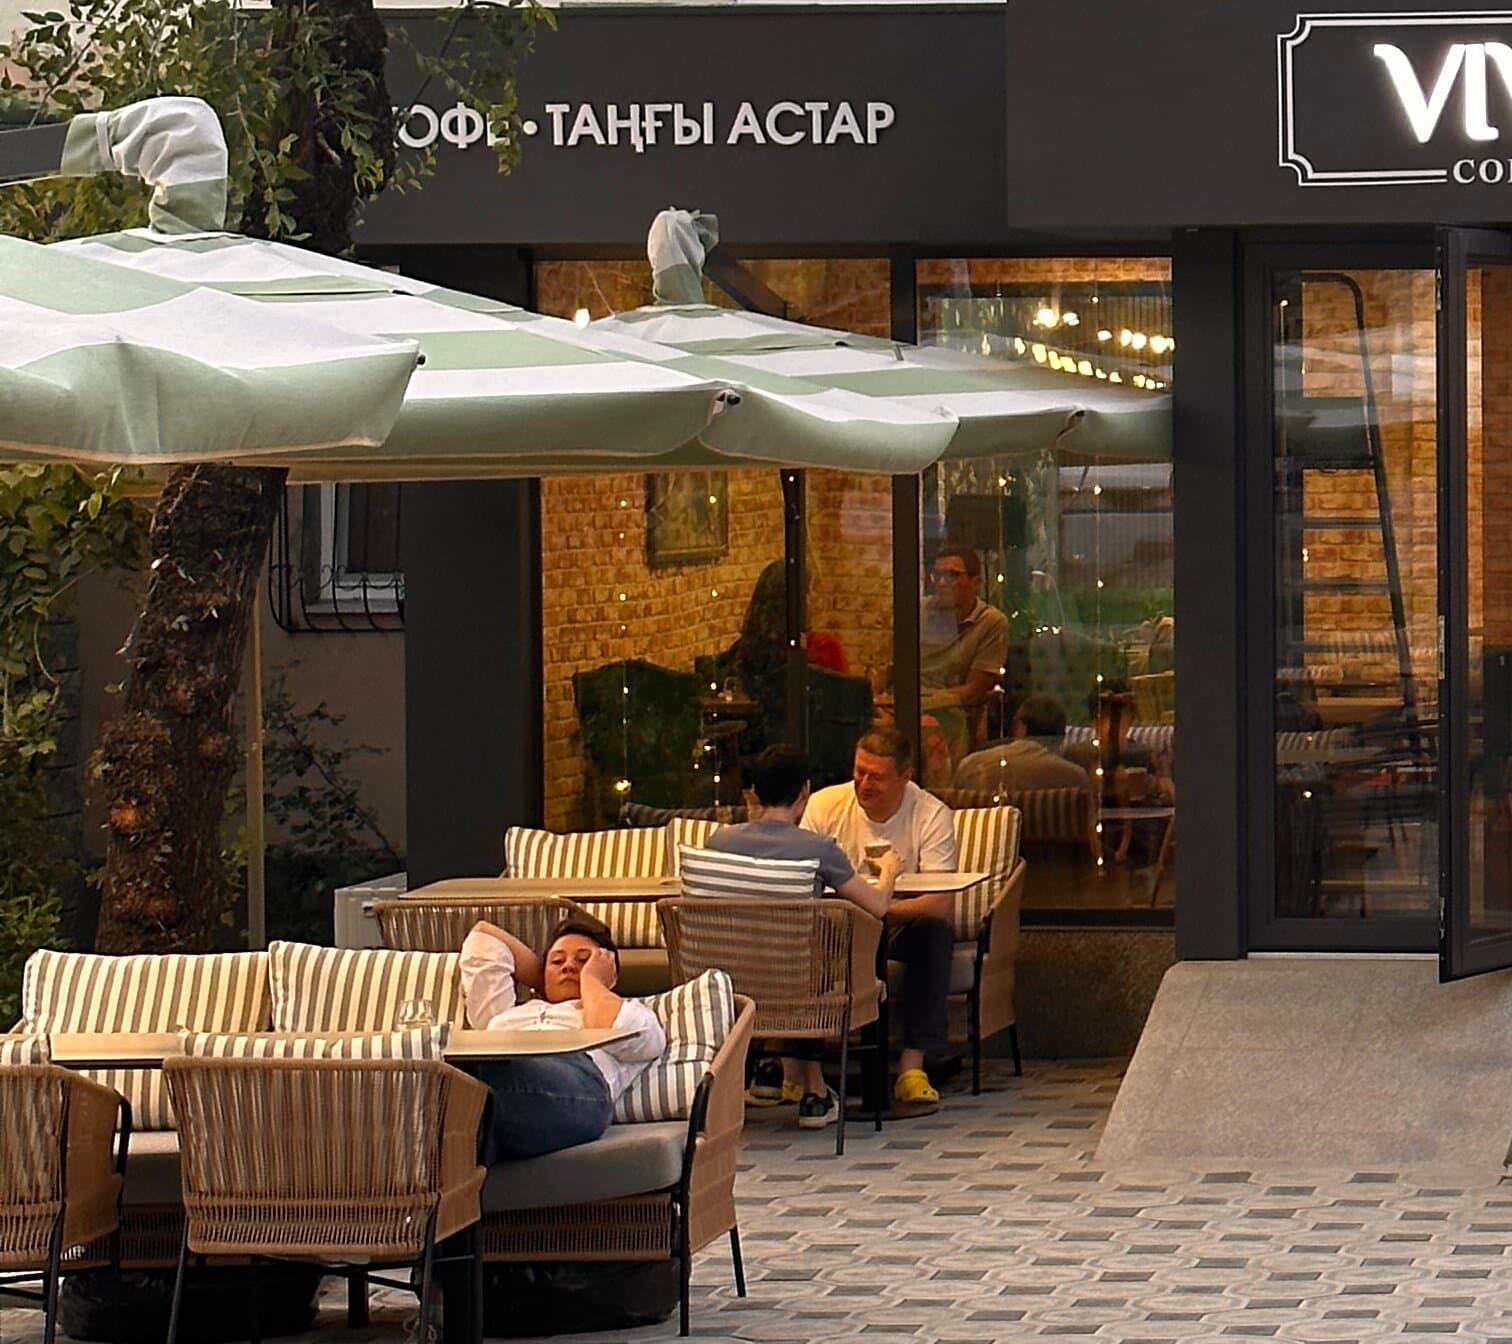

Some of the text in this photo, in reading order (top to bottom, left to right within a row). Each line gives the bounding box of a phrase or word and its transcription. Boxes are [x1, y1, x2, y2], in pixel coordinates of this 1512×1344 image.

[391, 101, 895, 153] ОФЕ ТАҢҒЫ АСТАР
